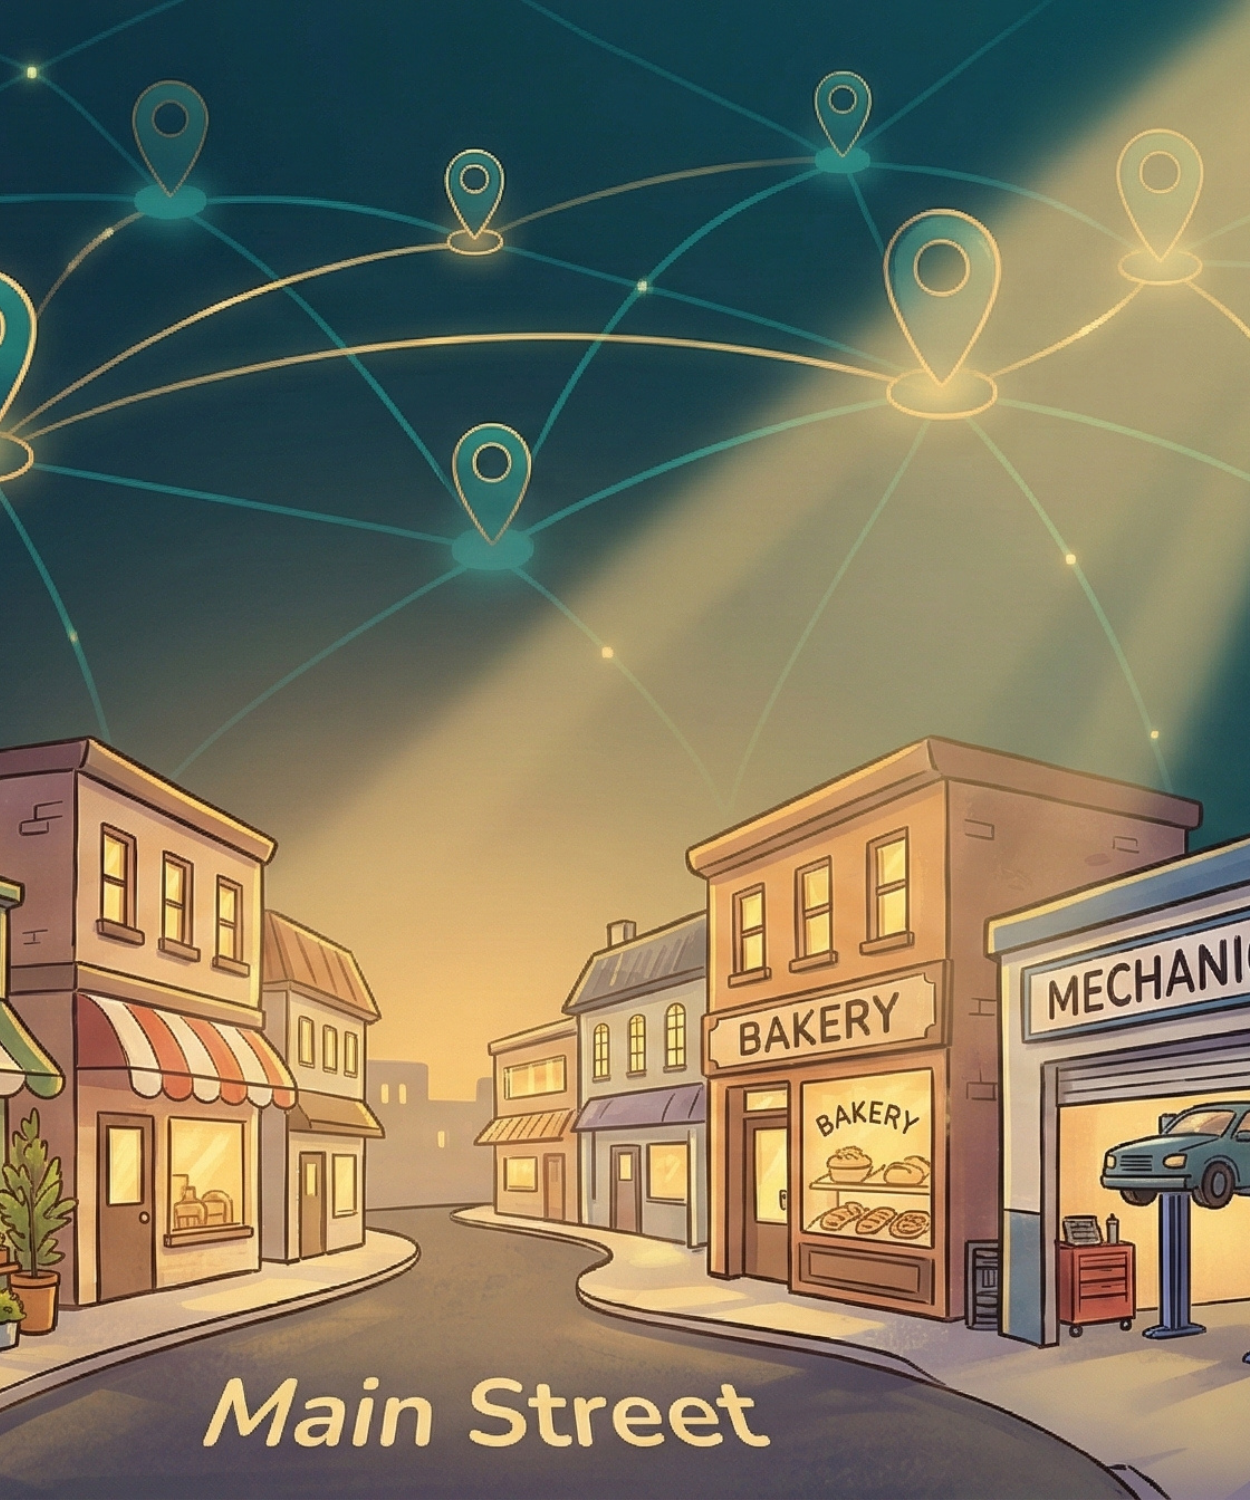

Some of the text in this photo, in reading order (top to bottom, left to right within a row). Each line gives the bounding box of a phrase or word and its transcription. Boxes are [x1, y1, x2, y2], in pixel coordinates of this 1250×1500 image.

[739, 992, 900, 1056] BAKERY
[815, 1100, 920, 1137] BAKERY
[203, 1377, 770, 1448] Main Street
